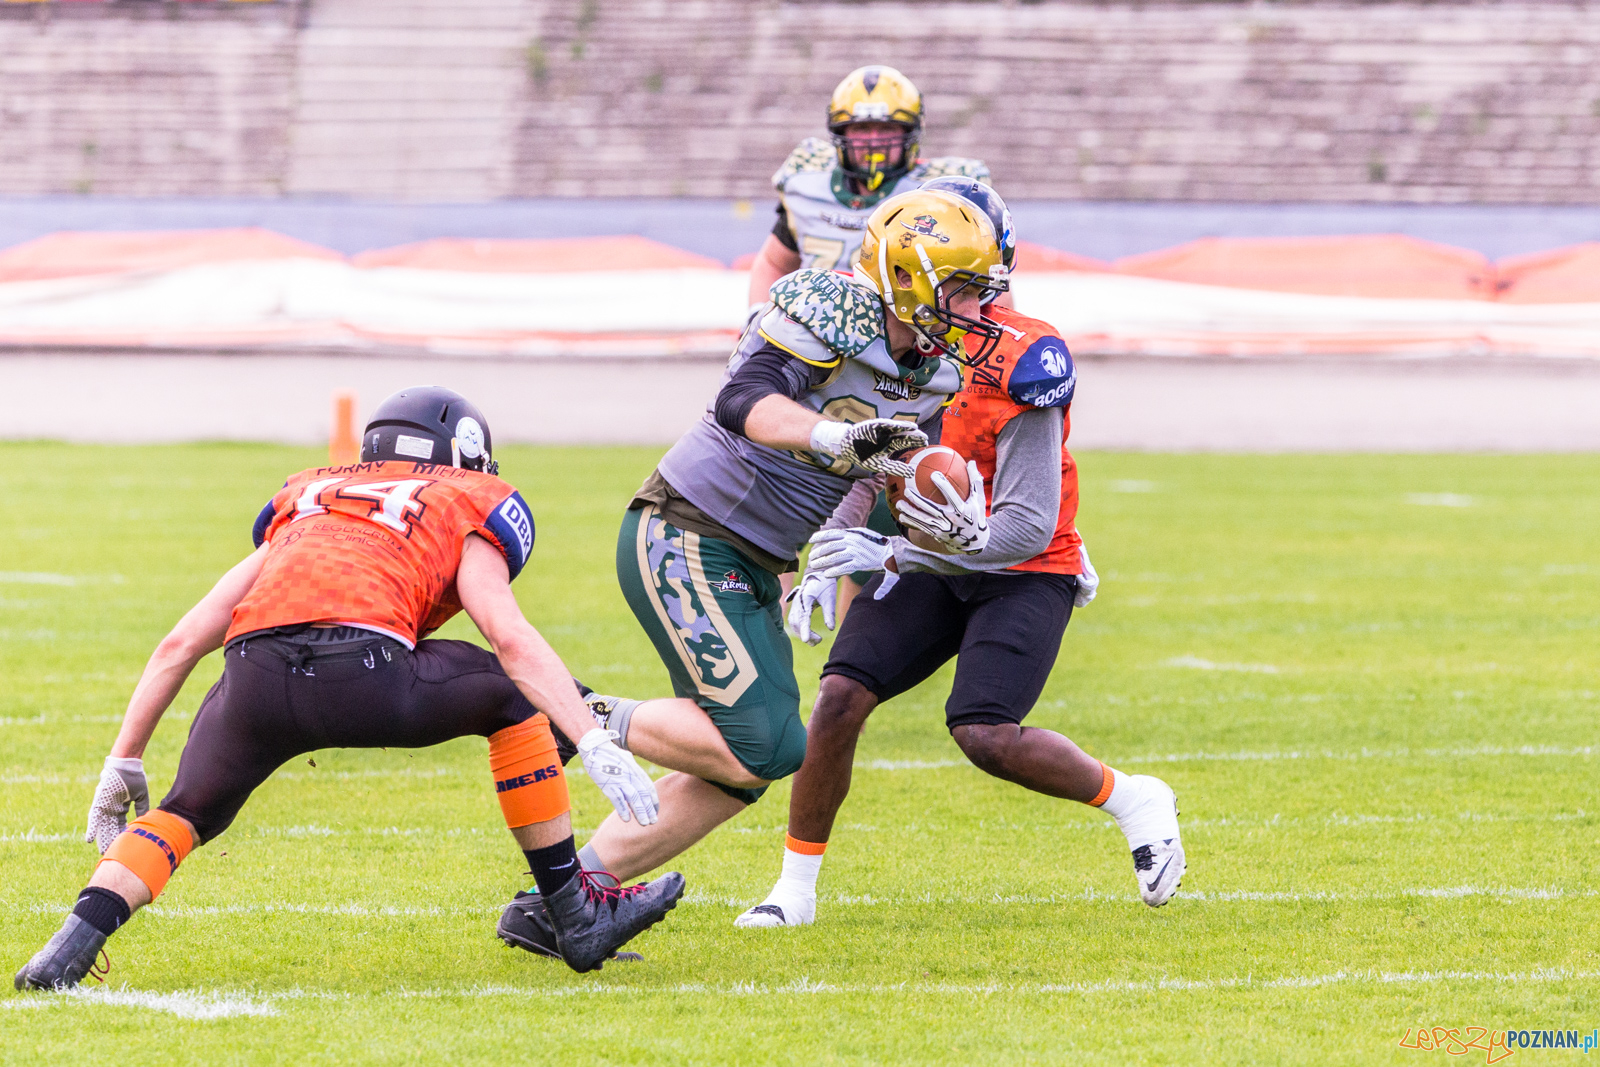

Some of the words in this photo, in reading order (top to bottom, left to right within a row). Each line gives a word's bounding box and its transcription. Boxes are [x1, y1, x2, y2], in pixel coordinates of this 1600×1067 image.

[875, 374, 908, 399] ARMIA
[287, 477, 437, 538] 14
[332, 533, 376, 547] Clinic
[722, 581, 749, 591] ARMIA
[495, 764, 560, 794] AKERS
